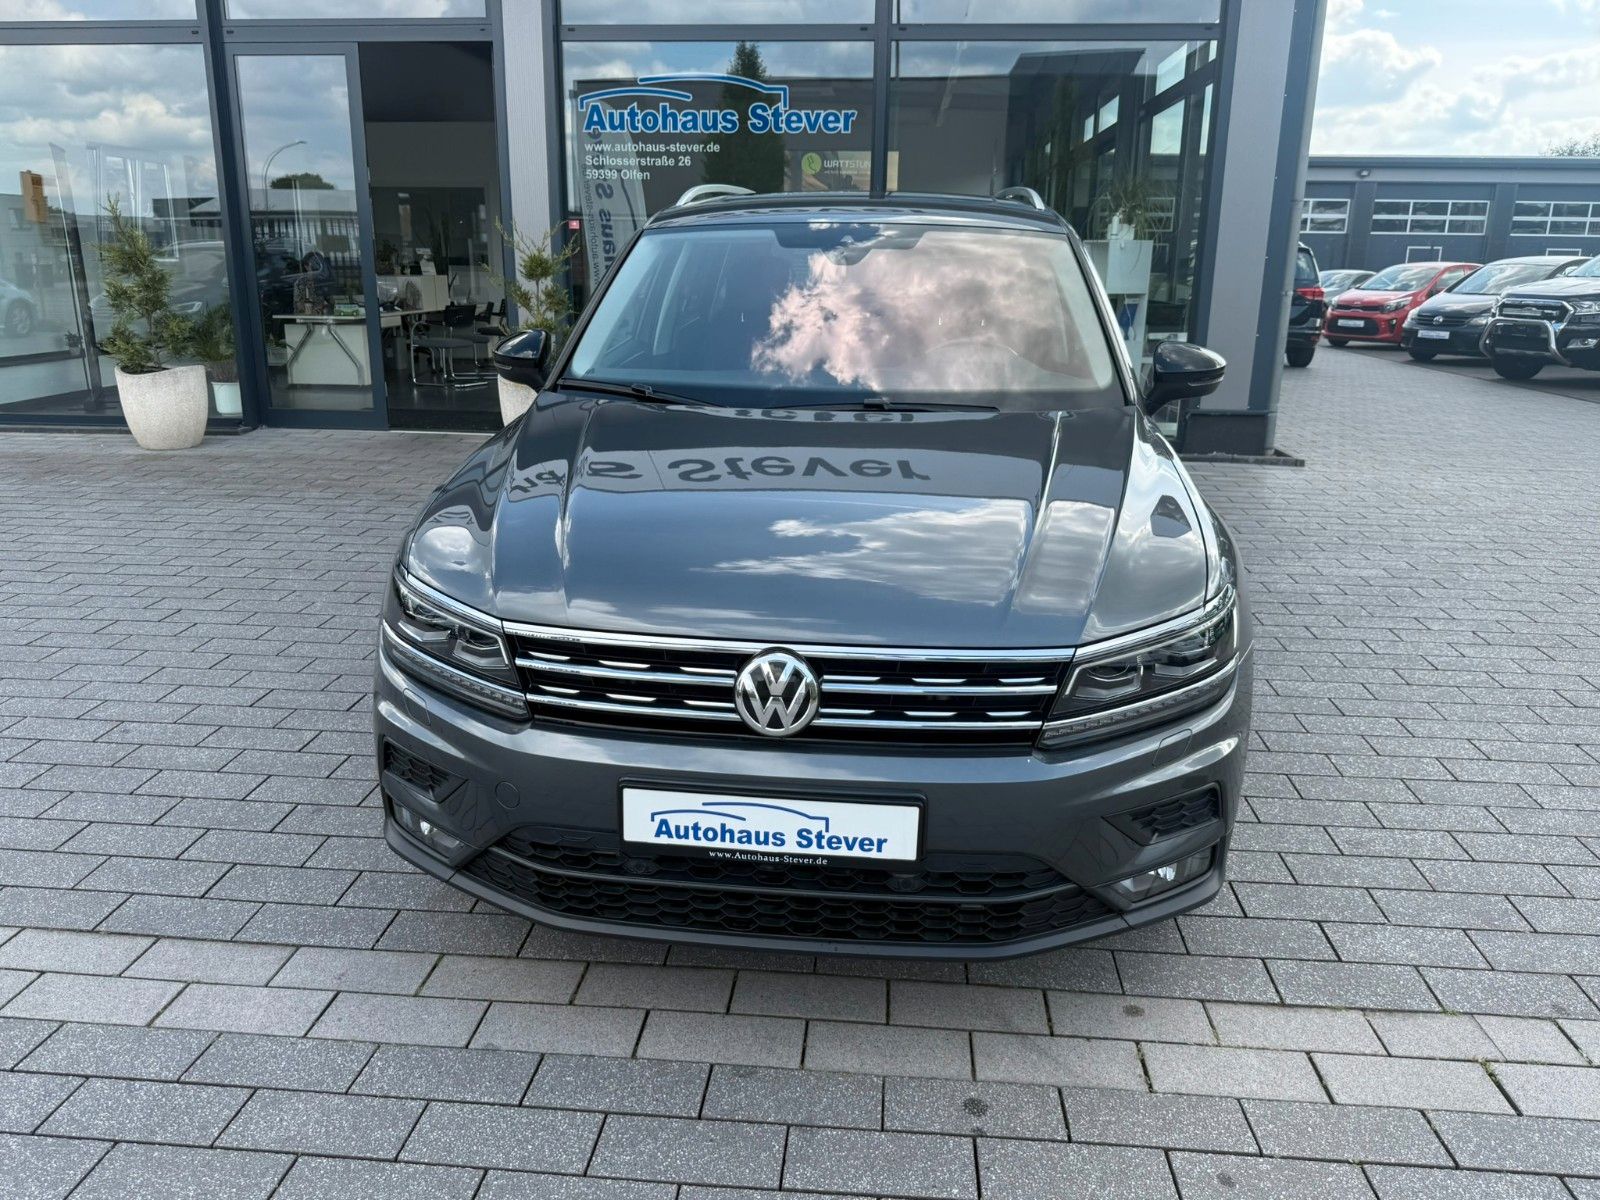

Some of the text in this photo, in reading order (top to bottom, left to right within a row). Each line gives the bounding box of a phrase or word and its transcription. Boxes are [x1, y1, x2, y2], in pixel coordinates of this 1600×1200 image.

[583, 102, 858, 134] Autohaus Stever
[584, 142, 720, 153] www.autohaus-stever.de
[585, 156, 691, 166] Schlosserstraße 26
[586, 169, 651, 180] 59399 Olfen
[654, 818, 888, 853] Autohaus Stever
[708, 849, 828, 866] www.Autohaus-Stever.de
